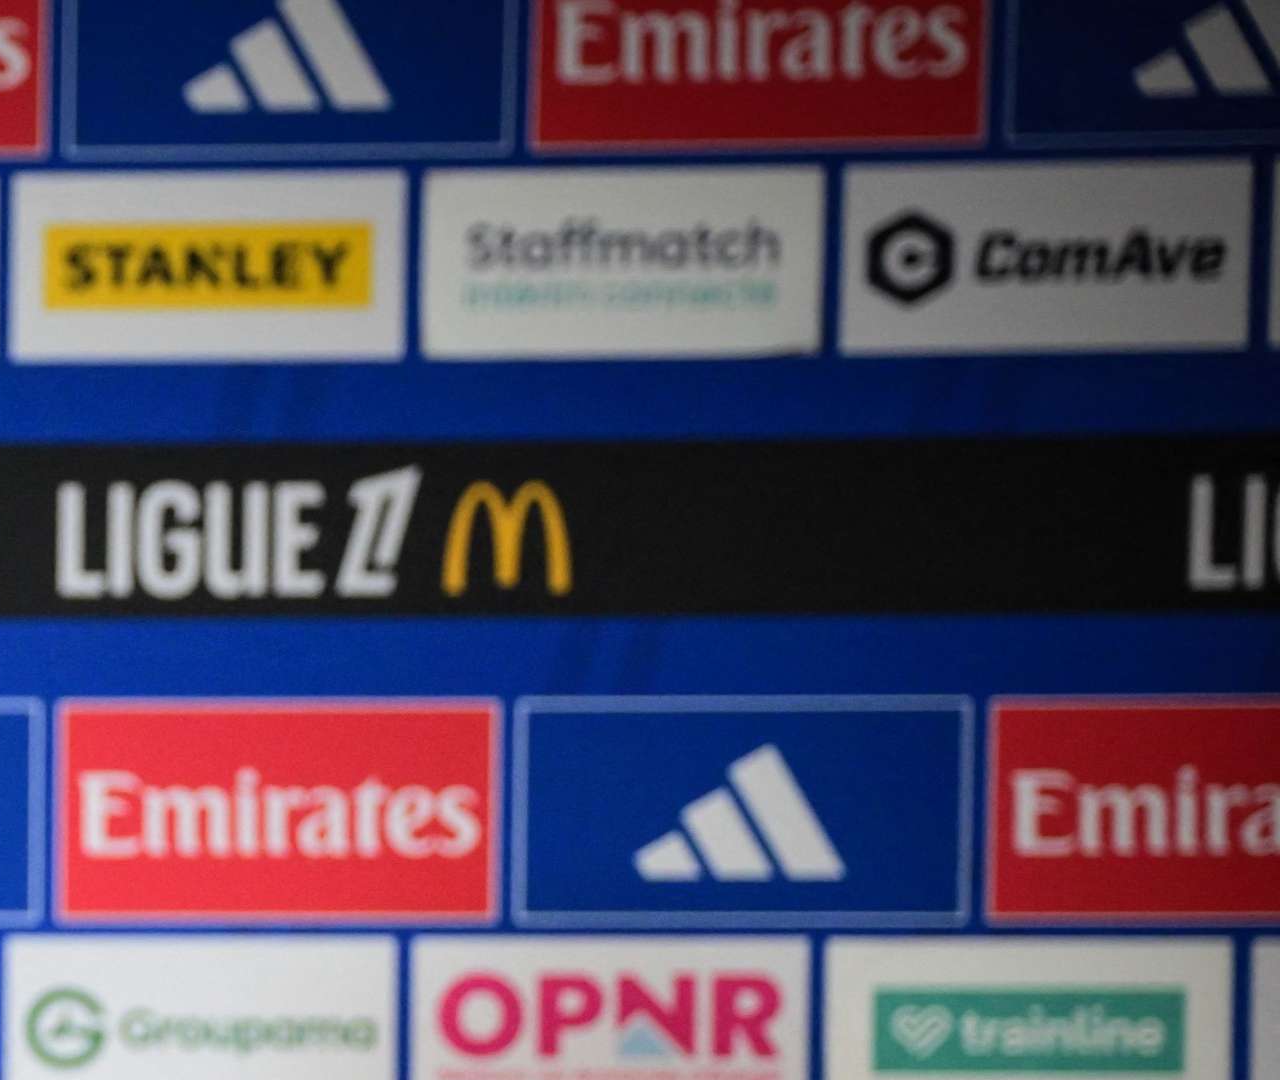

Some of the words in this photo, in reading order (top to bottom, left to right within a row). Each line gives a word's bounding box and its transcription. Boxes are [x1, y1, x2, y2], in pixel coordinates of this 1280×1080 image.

[554, 0, 967, 85] Emirates
[64, 241, 352, 291] STANLEY
[465, 215, 784, 271] Staffmatch
[974, 227, 1230, 283] ComAve
[55, 480, 326, 598] LIGUE
[78, 767, 482, 859] Emirates
[1010, 764, 1280, 857] Emira
[119, 1007, 381, 1055] Groupama
[438, 972, 783, 1058] OPNR
[956, 1003, 1166, 1058] trainline
